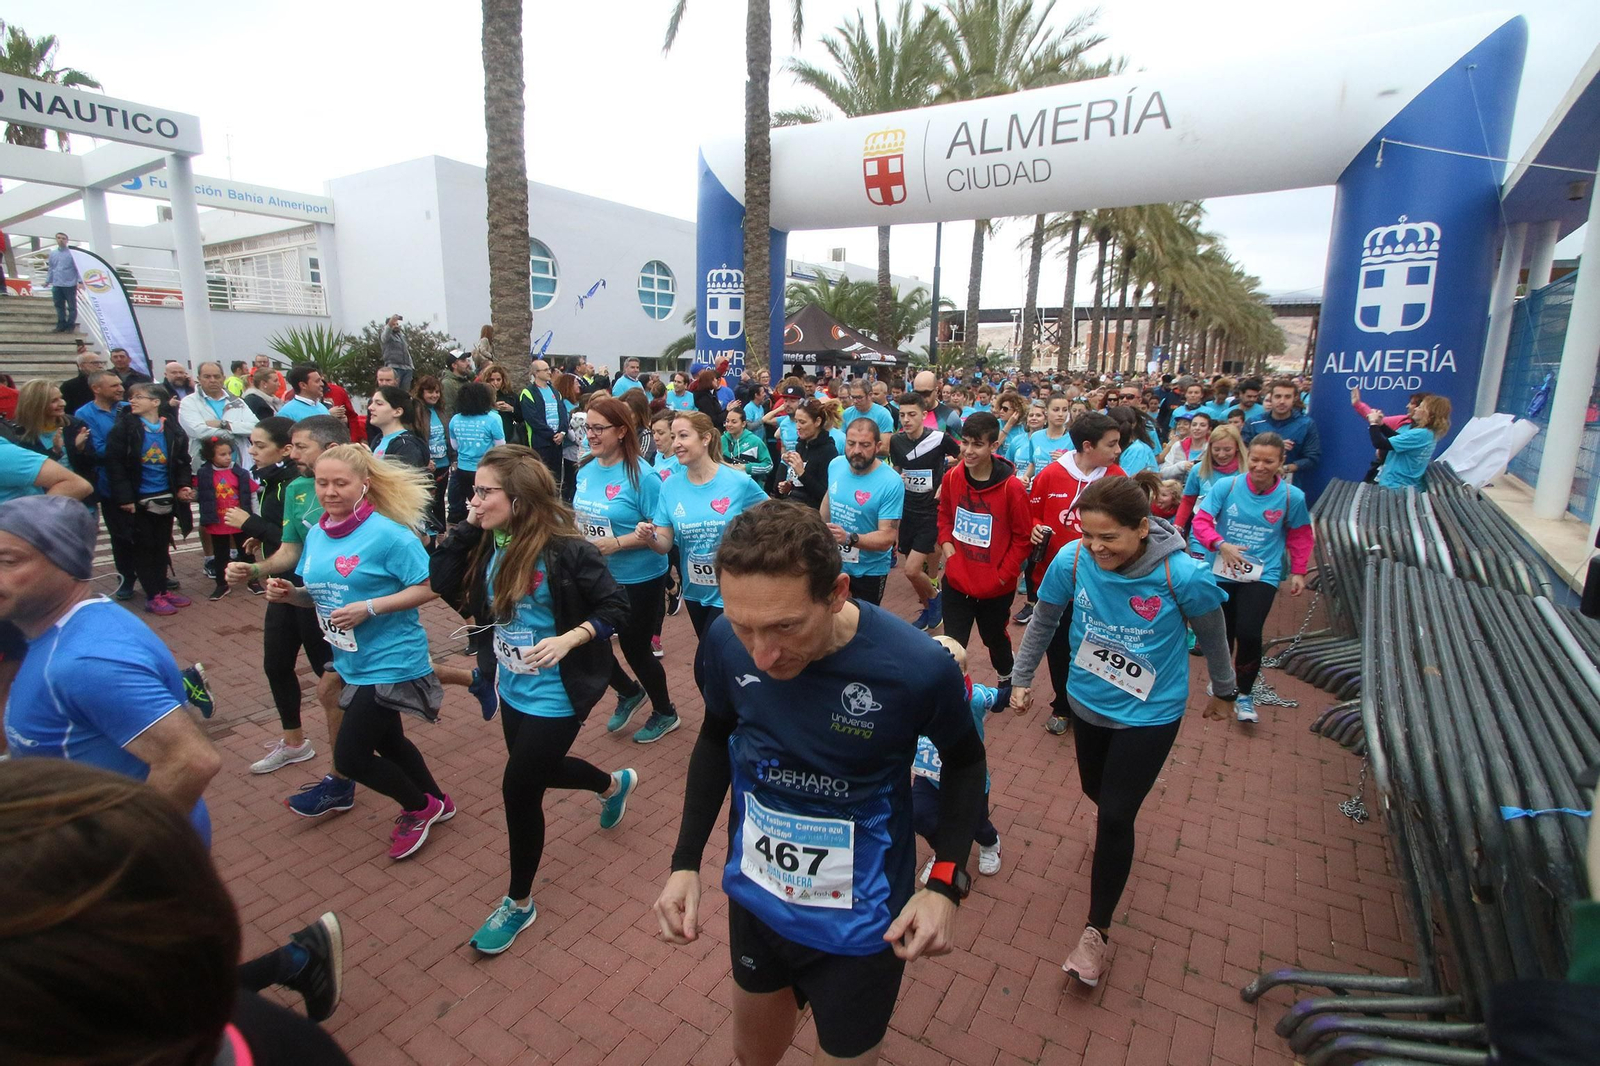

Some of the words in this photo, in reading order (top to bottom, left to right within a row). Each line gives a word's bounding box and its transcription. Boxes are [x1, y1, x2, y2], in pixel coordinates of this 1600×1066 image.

[18, 88, 179, 139] NAUTICO
[945, 87, 1172, 160] ALMERÍA
[946, 159, 1051, 192] CIUDAD
[268, 196, 329, 215] Almeriport
[1322, 343, 1457, 374] ALMERÍA
[1345, 375, 1422, 390] CIUDAD
[907, 477, 927, 485] 722
[583, 523, 606, 537] 596
[957, 518, 989, 536] 2176
[693, 564, 713, 575] 50
[1081, 611, 1087, 623] I
[1088, 616, 1118, 632] Runner
[1119, 625, 1155, 635] Fashion
[1093, 649, 1142, 678] 490
[831, 712, 874, 729] Universo
[830, 722, 874, 739] Running
[768, 767, 849, 793] DEHARO
[763, 824, 792, 839] autismo
[795, 822, 827, 833] Carrera
[828, 826, 843, 835] azul
[755, 834, 829, 876] 467
[782, 872, 813, 888] GALERA
